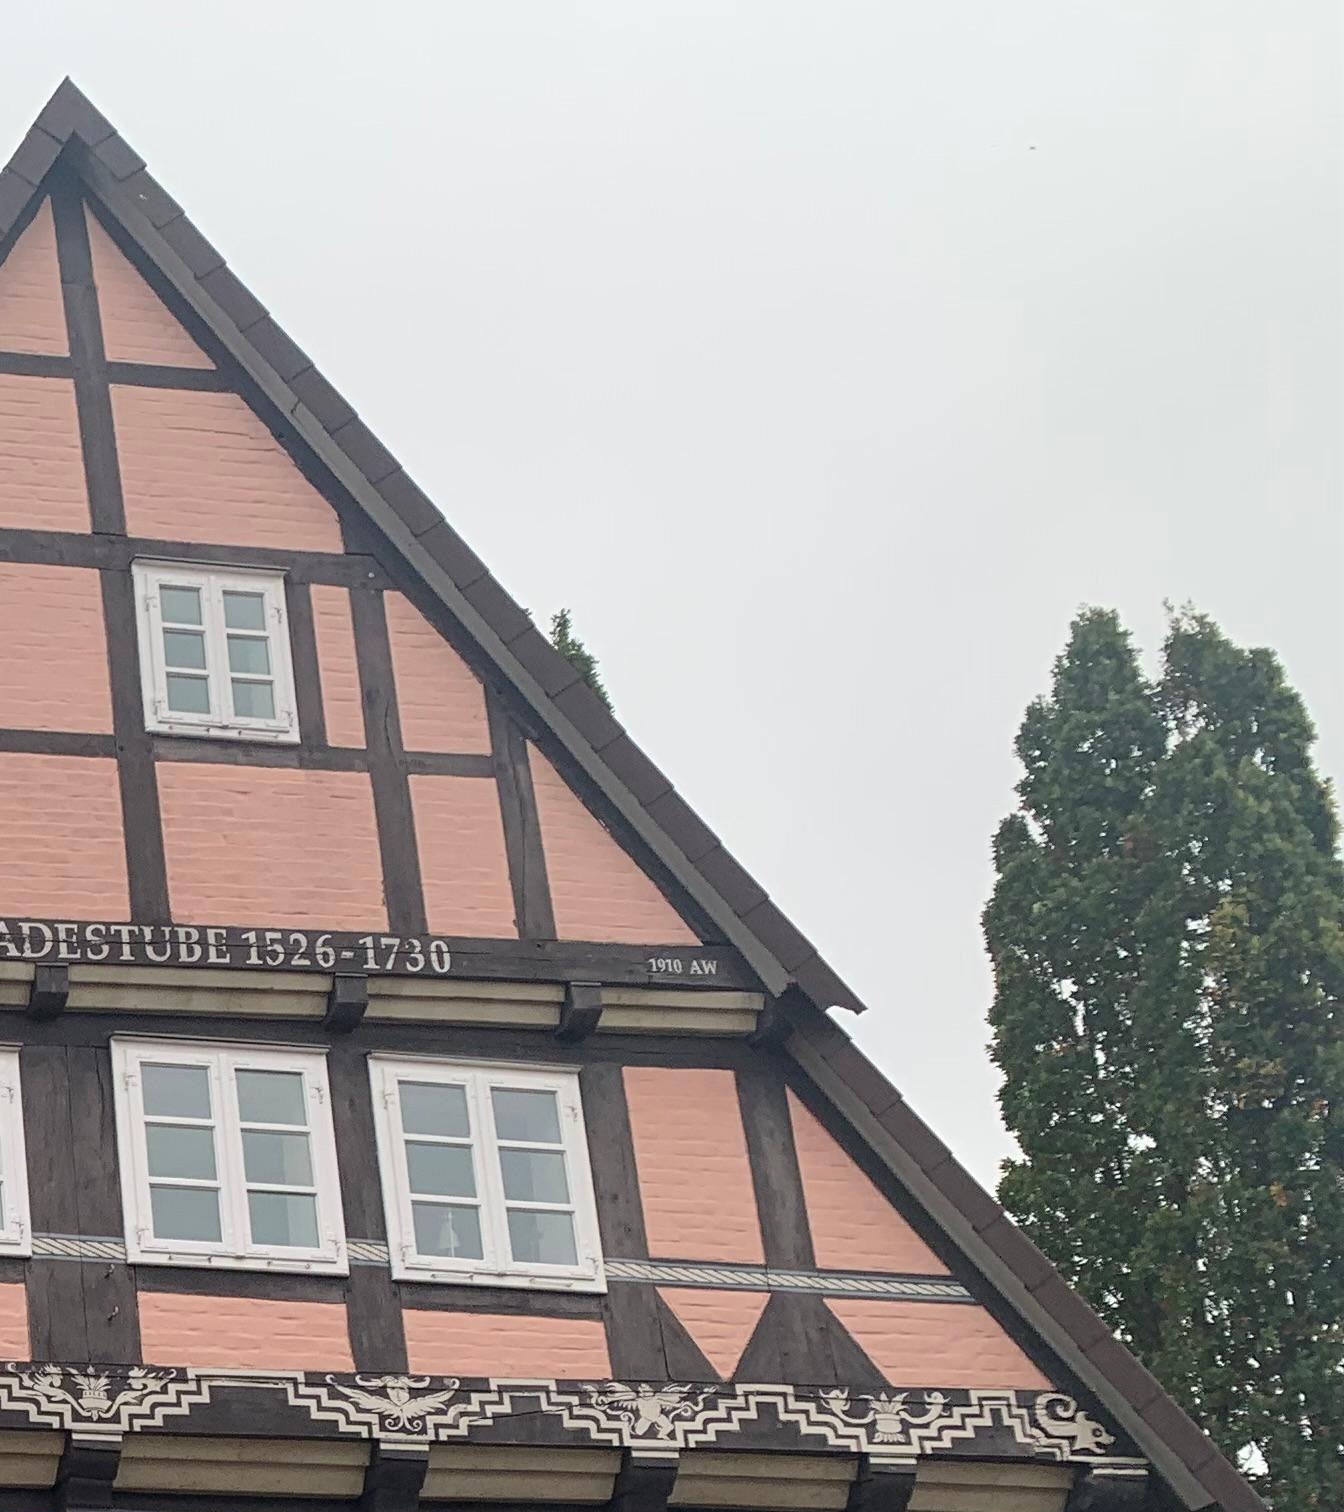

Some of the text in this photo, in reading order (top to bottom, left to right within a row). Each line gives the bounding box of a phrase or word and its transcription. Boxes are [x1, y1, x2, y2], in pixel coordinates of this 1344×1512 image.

[241, 931, 452, 973] 1526-1730
[648, 958, 718, 974] 1910 AW
